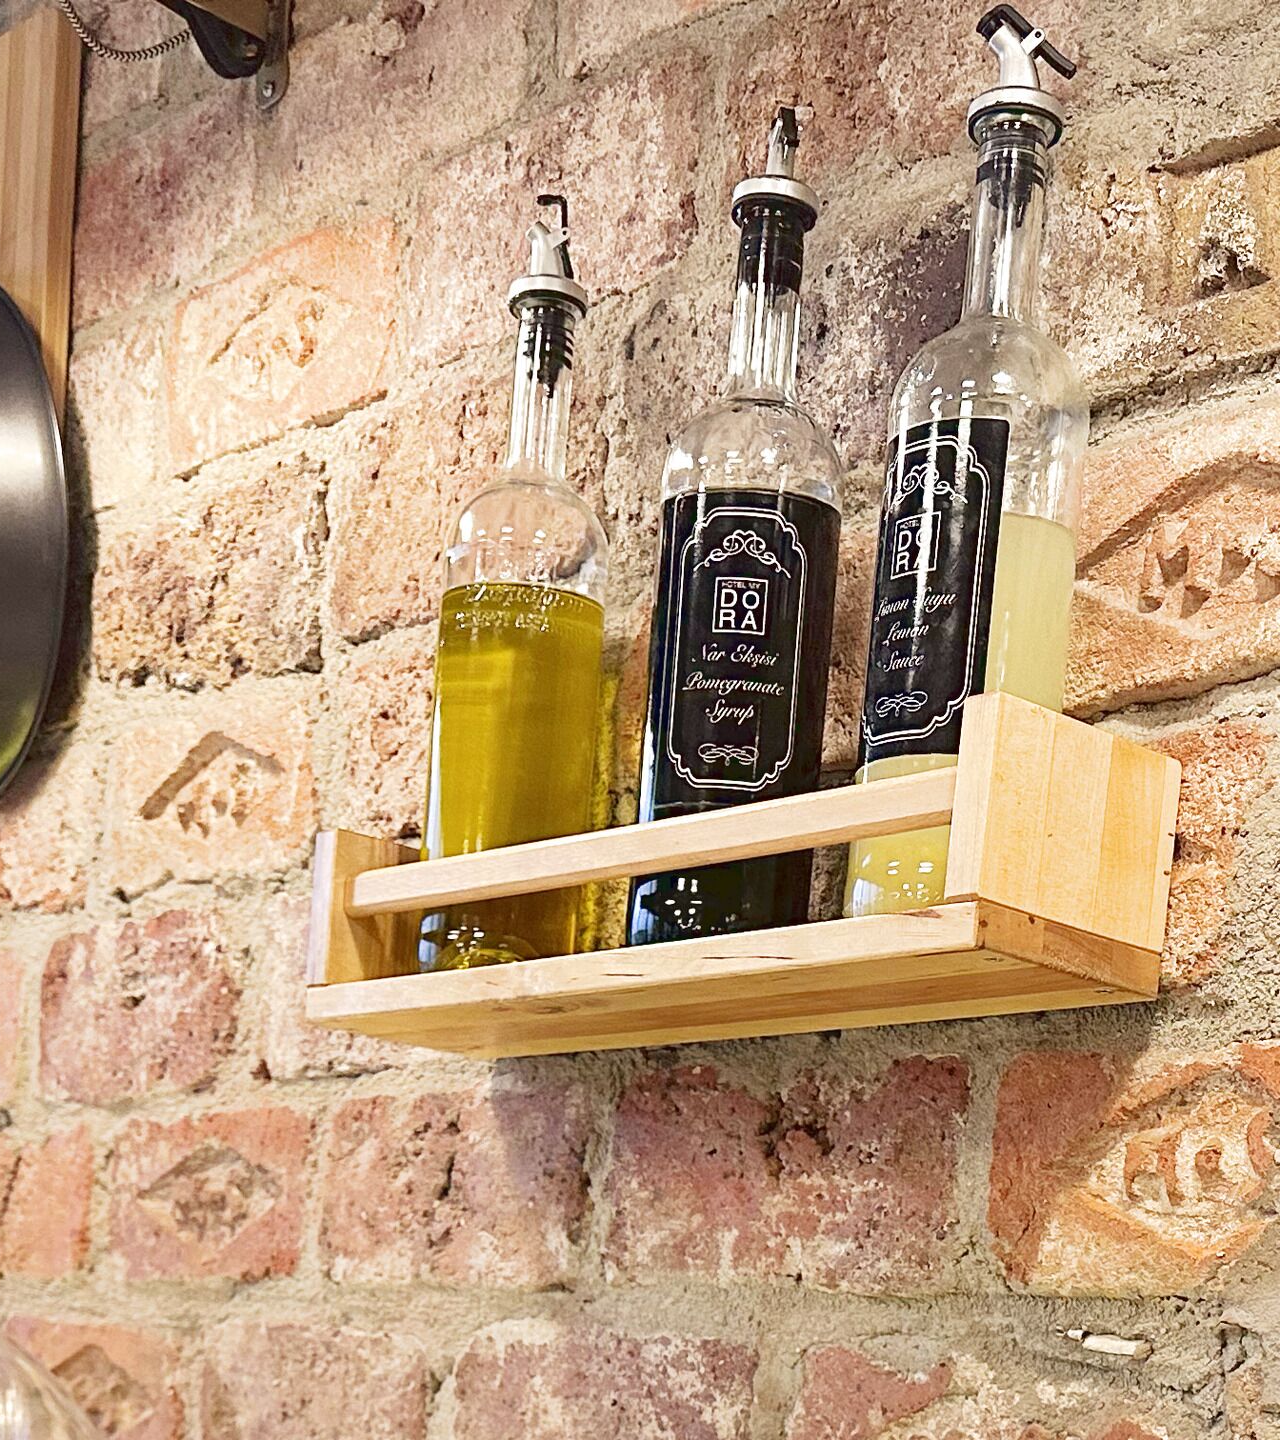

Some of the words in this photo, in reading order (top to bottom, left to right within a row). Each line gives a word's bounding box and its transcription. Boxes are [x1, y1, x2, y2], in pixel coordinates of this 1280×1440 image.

[721, 580, 747, 589] HOTEL
[721, 588, 760, 610] DO
[719, 608, 757, 630] RA
[882, 620, 930, 647] Lemon
[877, 650, 926, 673] Sauce
[682, 671, 785, 697] Pomegranate
[705, 698, 755, 726] Syrup
